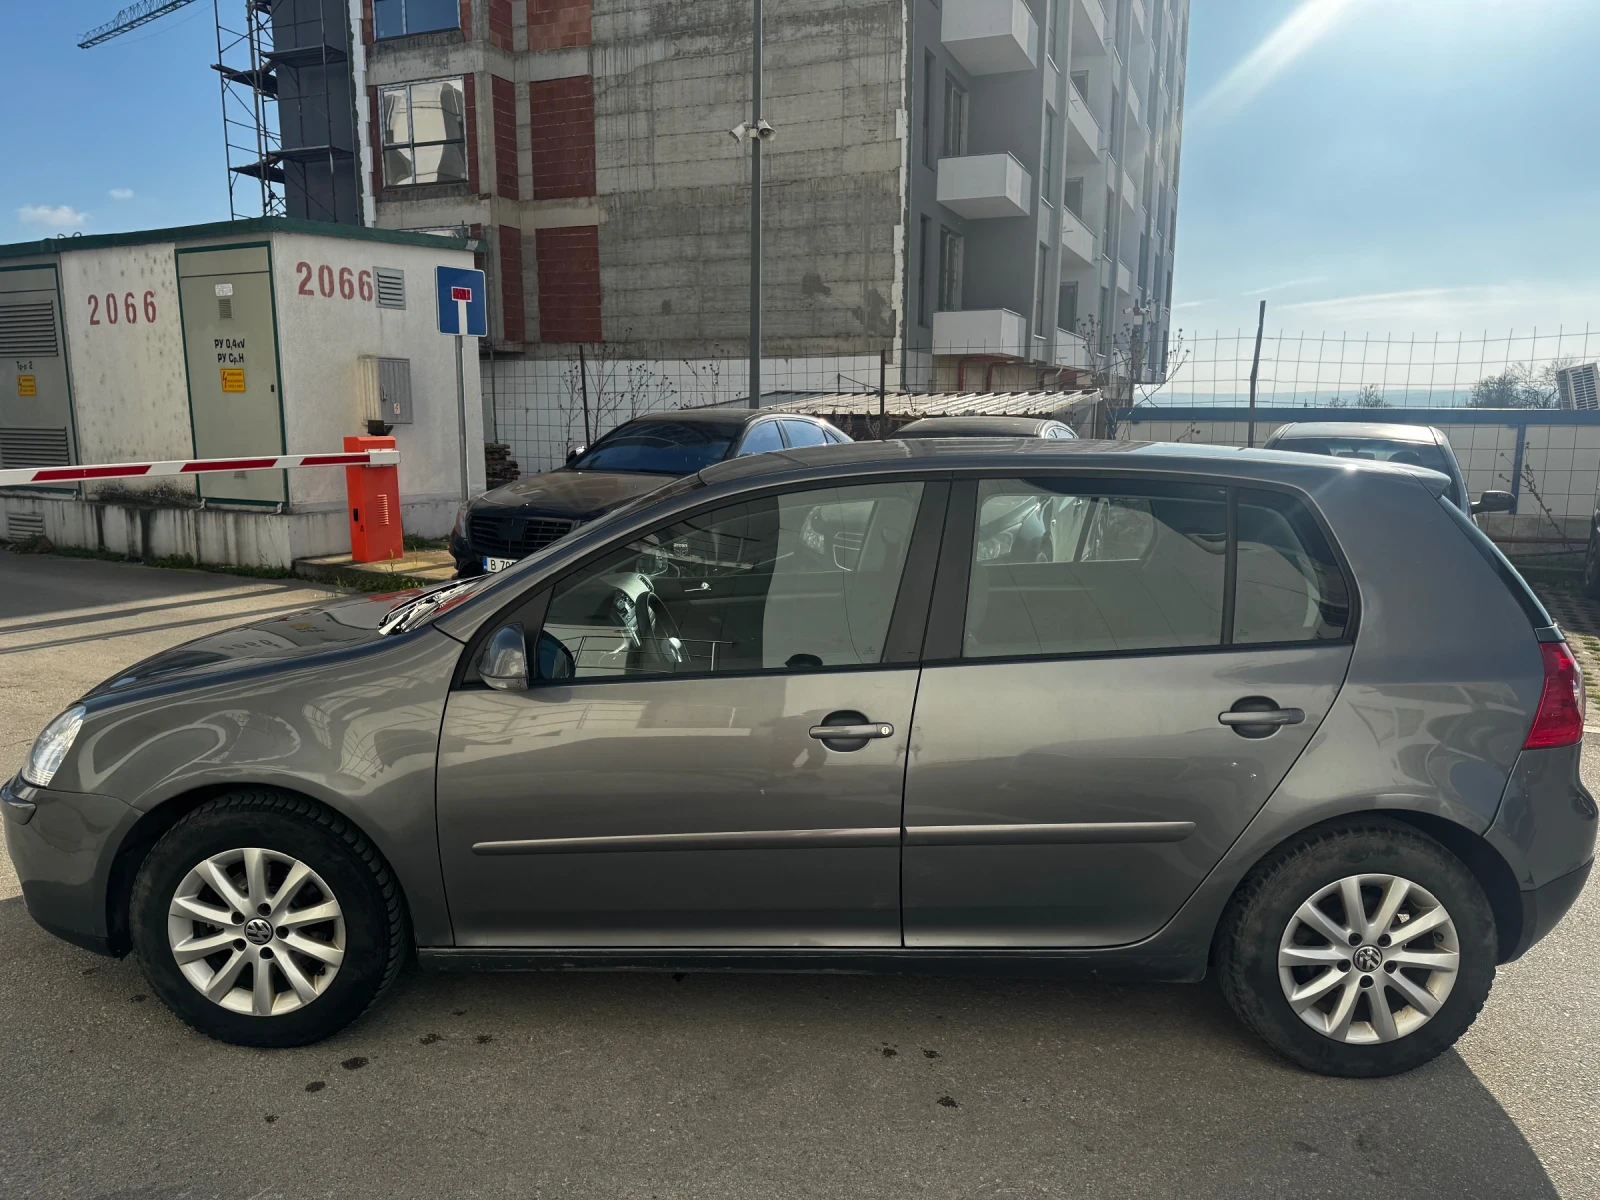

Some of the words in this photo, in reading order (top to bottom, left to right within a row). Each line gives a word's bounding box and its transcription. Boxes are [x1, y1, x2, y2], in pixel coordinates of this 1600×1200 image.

[296, 261, 373, 302] 2066
[87, 290, 157, 326] 2066
[490, 559, 497, 571] B
